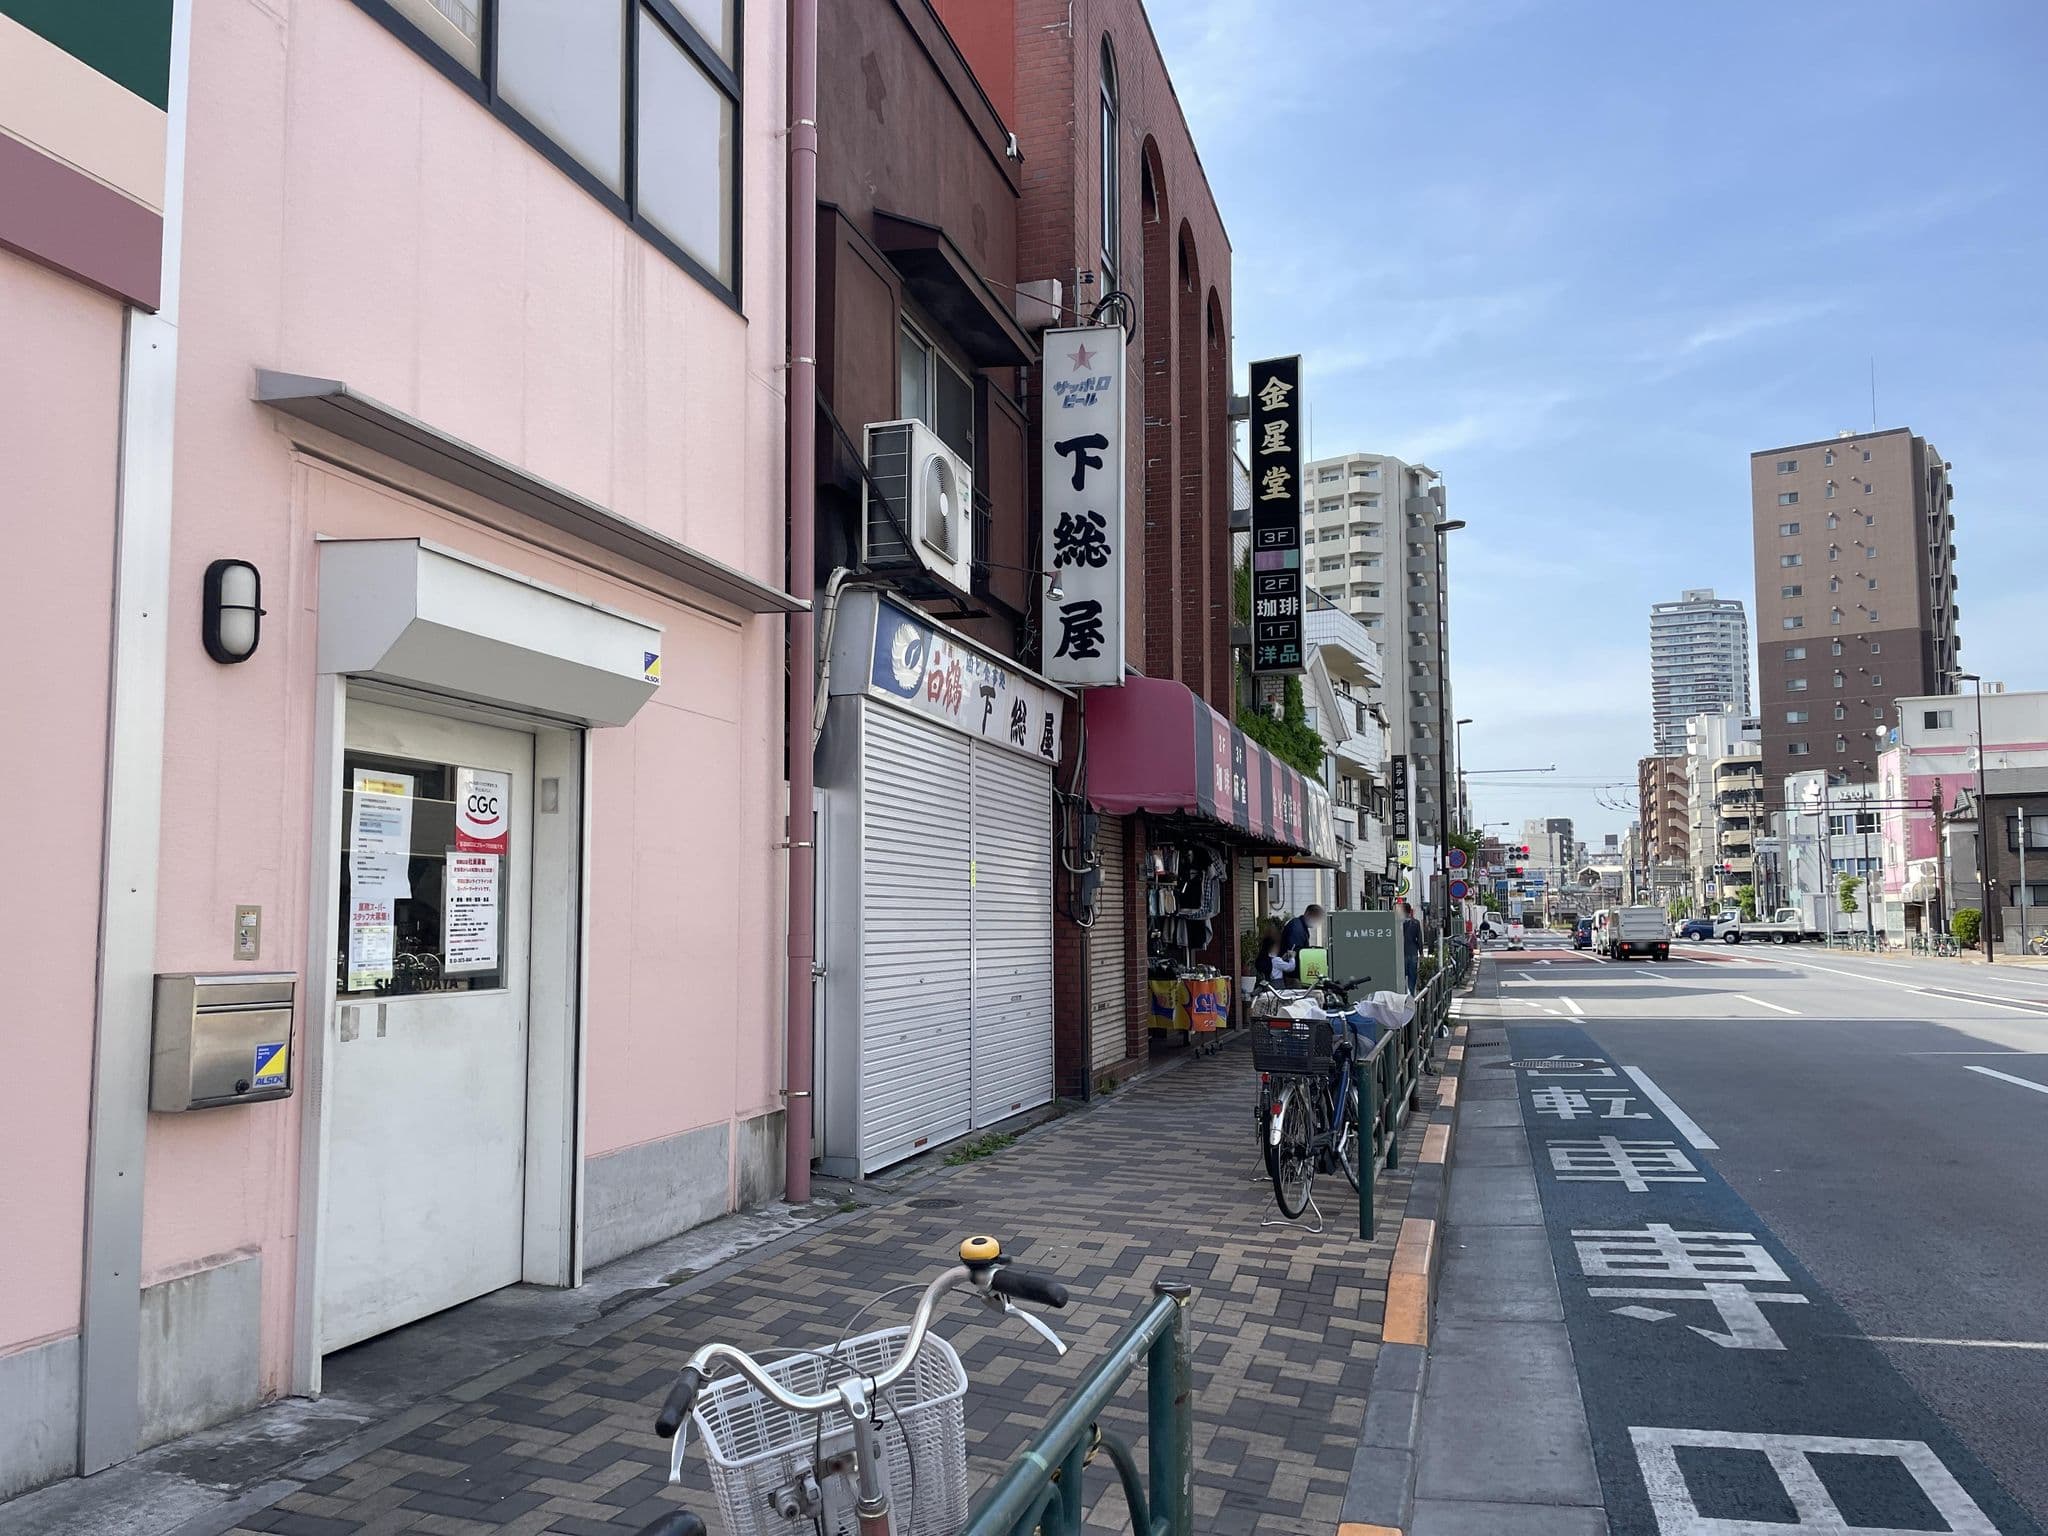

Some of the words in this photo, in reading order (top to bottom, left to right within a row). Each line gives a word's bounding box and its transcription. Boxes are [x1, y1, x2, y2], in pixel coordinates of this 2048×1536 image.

[1053, 376, 1112, 396] サッポロ
[1061, 394, 1099, 409] ビール
[1257, 375, 1295, 501] 金星堂
[1053, 433, 1112, 660] 下総屋
[1264, 531, 1289, 544] 3F
[1264, 578, 1289, 591] 2F
[1256, 596, 1299, 618] 珈琲
[1266, 624, 1290, 637] 1F
[1258, 644, 1300, 665] 洋品
[979, 684, 1056, 760] 下総屋
[1395, 761, 1404, 785] ホテル
[467, 795, 498, 815] CGC
[255, 1076, 283, 1086] ALSOK
